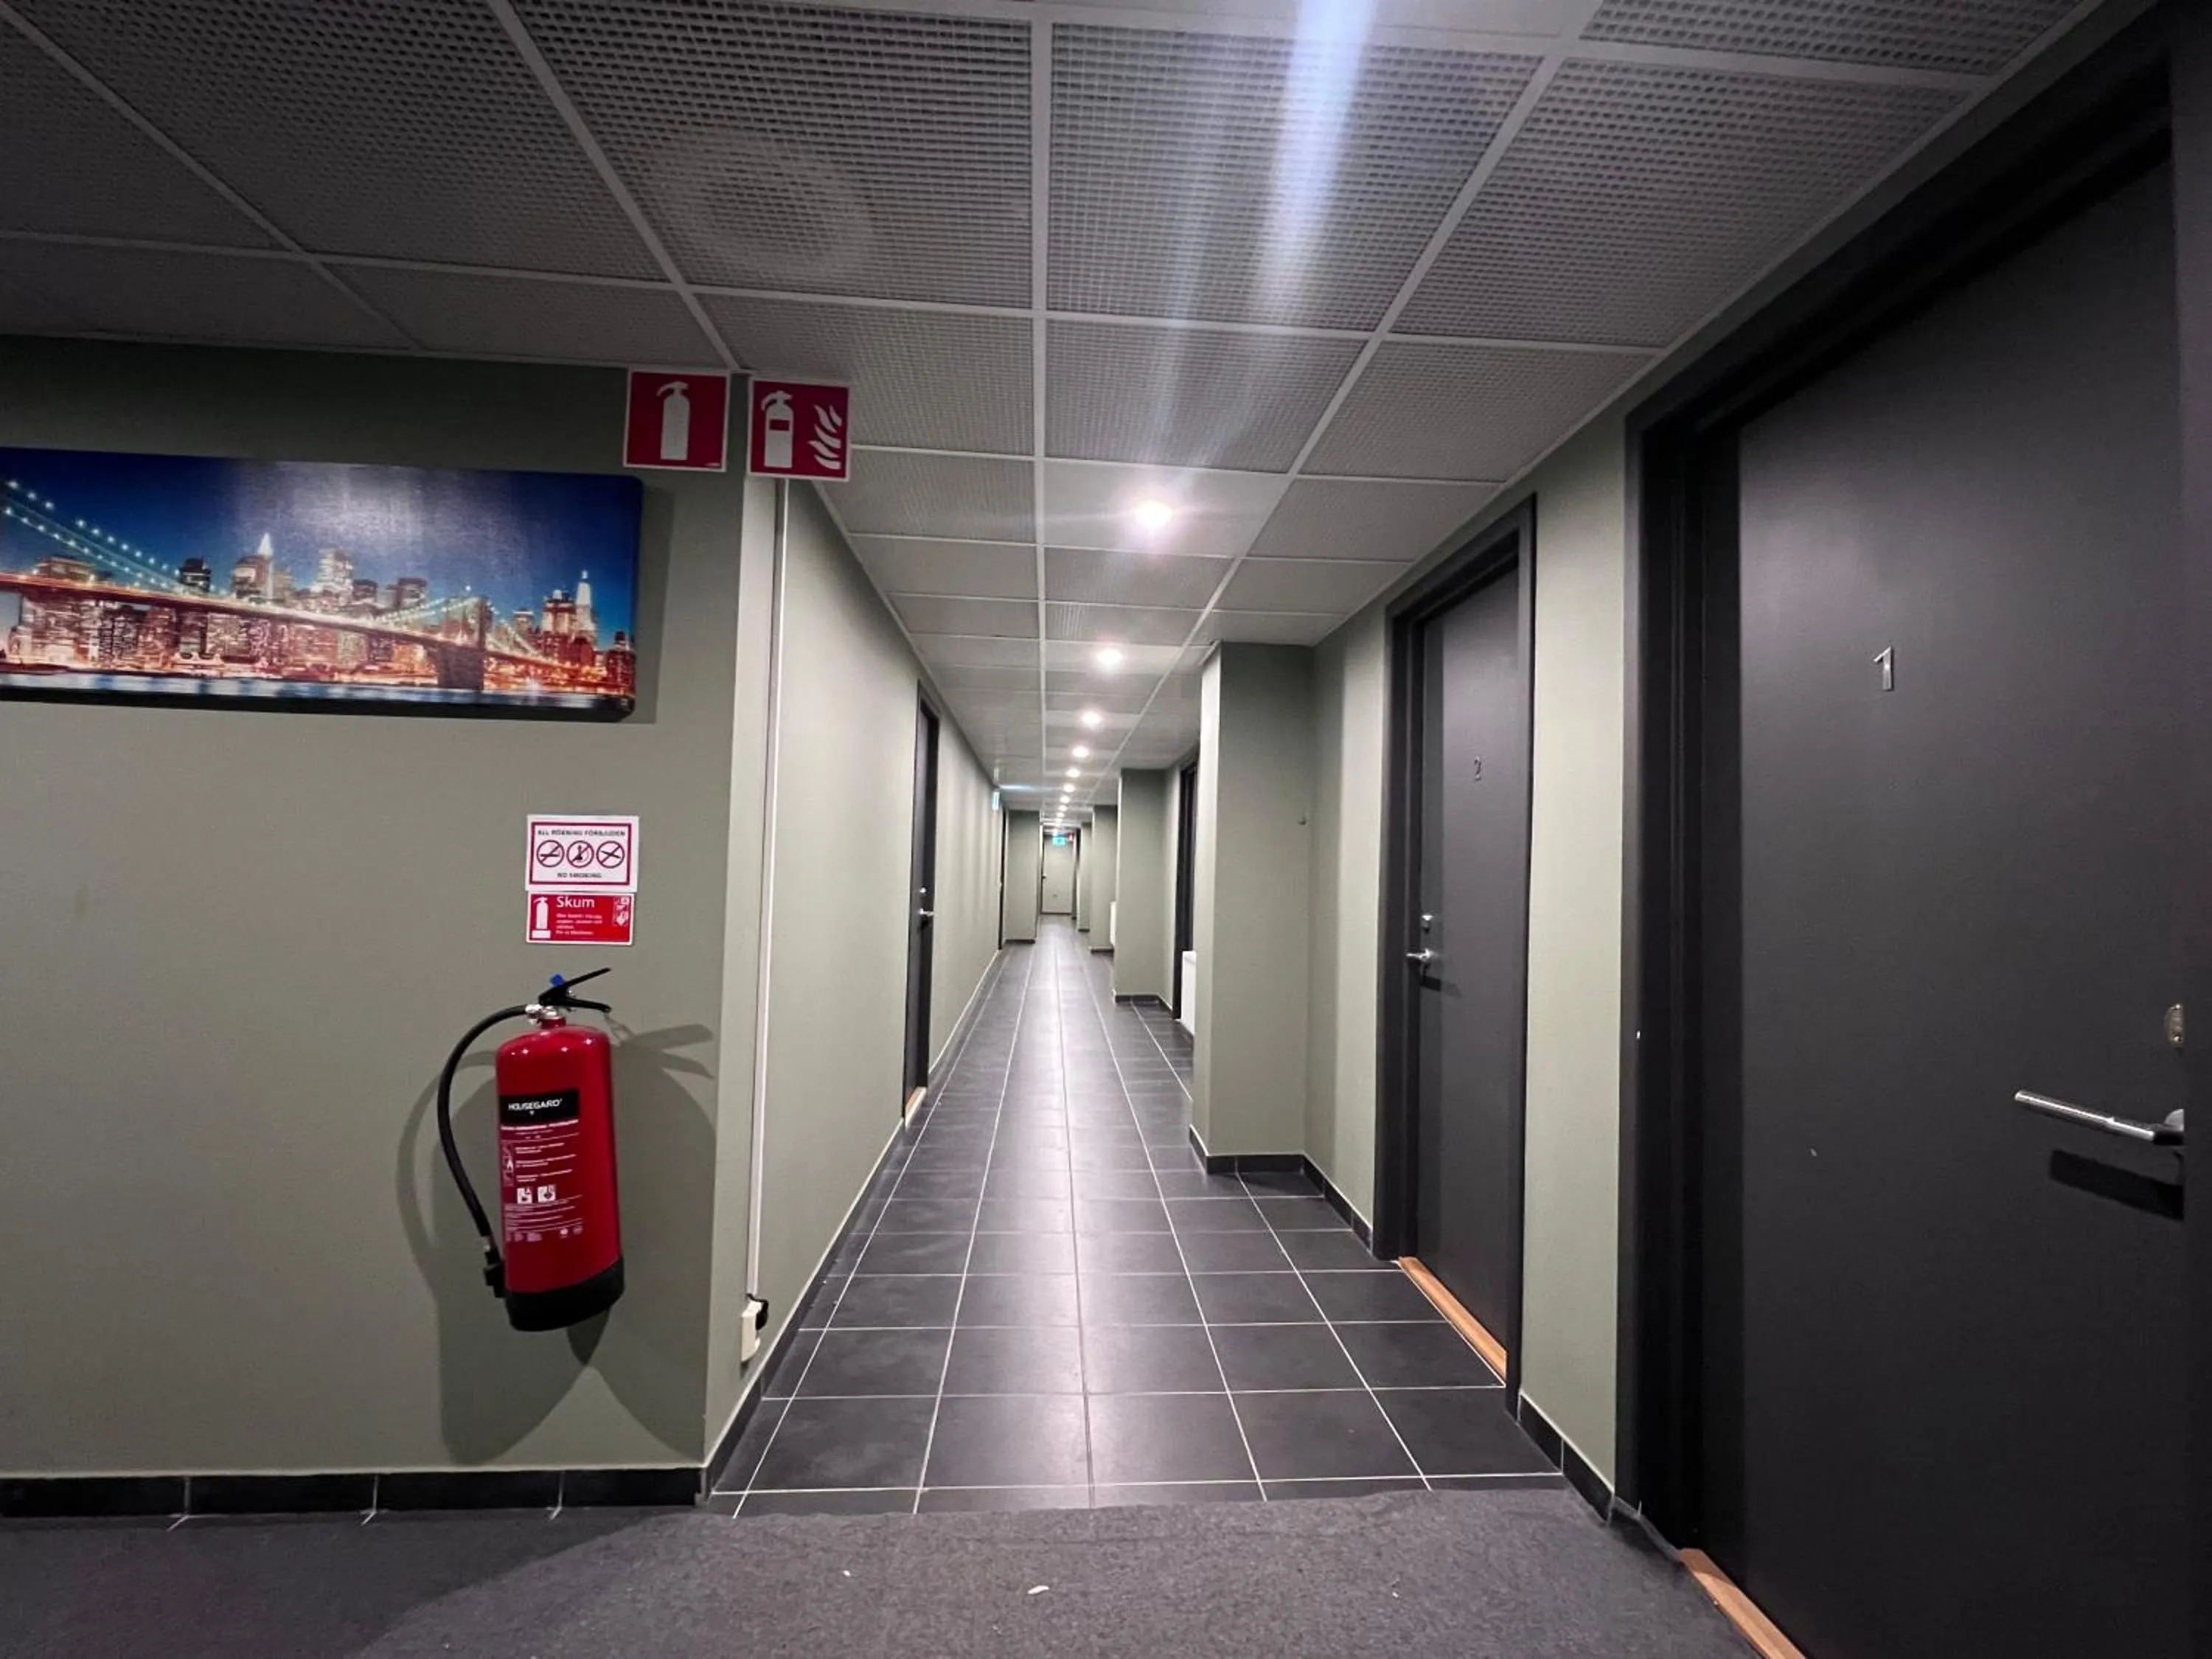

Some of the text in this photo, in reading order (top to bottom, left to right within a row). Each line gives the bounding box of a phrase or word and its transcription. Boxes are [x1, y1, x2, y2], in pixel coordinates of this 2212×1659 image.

[1874, 646, 1893, 691] 1
[1474, 755, 1482, 782] 2
[556, 896, 595, 908] Skum
